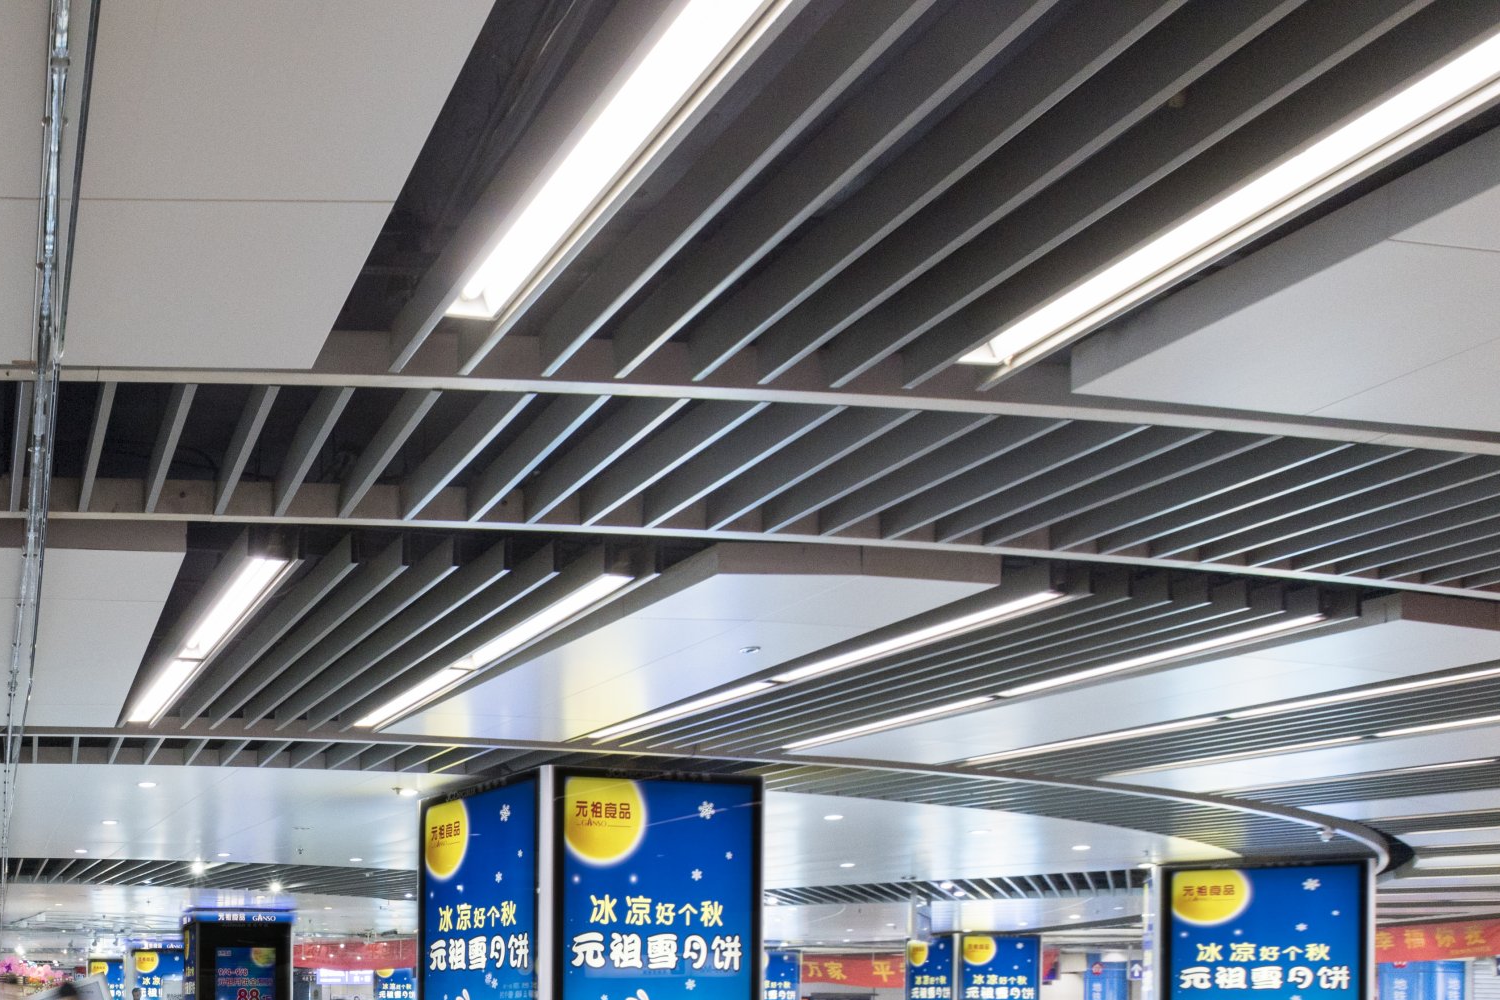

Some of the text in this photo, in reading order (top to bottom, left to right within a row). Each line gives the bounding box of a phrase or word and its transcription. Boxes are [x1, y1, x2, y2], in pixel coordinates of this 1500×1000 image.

[252, 913, 277, 922] GANSO
[438, 900, 517, 932] 冰凉好个秋
[589, 894, 724, 927] 冰凉好个秋
[428, 932, 530, 972] 元祖雪月饼
[570, 931, 743, 972] 元祖雪月饼
[1196, 942, 1331, 963] 冰凉好个秋
[804, 960, 905, 983] 万家 平
[1178, 966, 1351, 990] 元祖雪月饼
